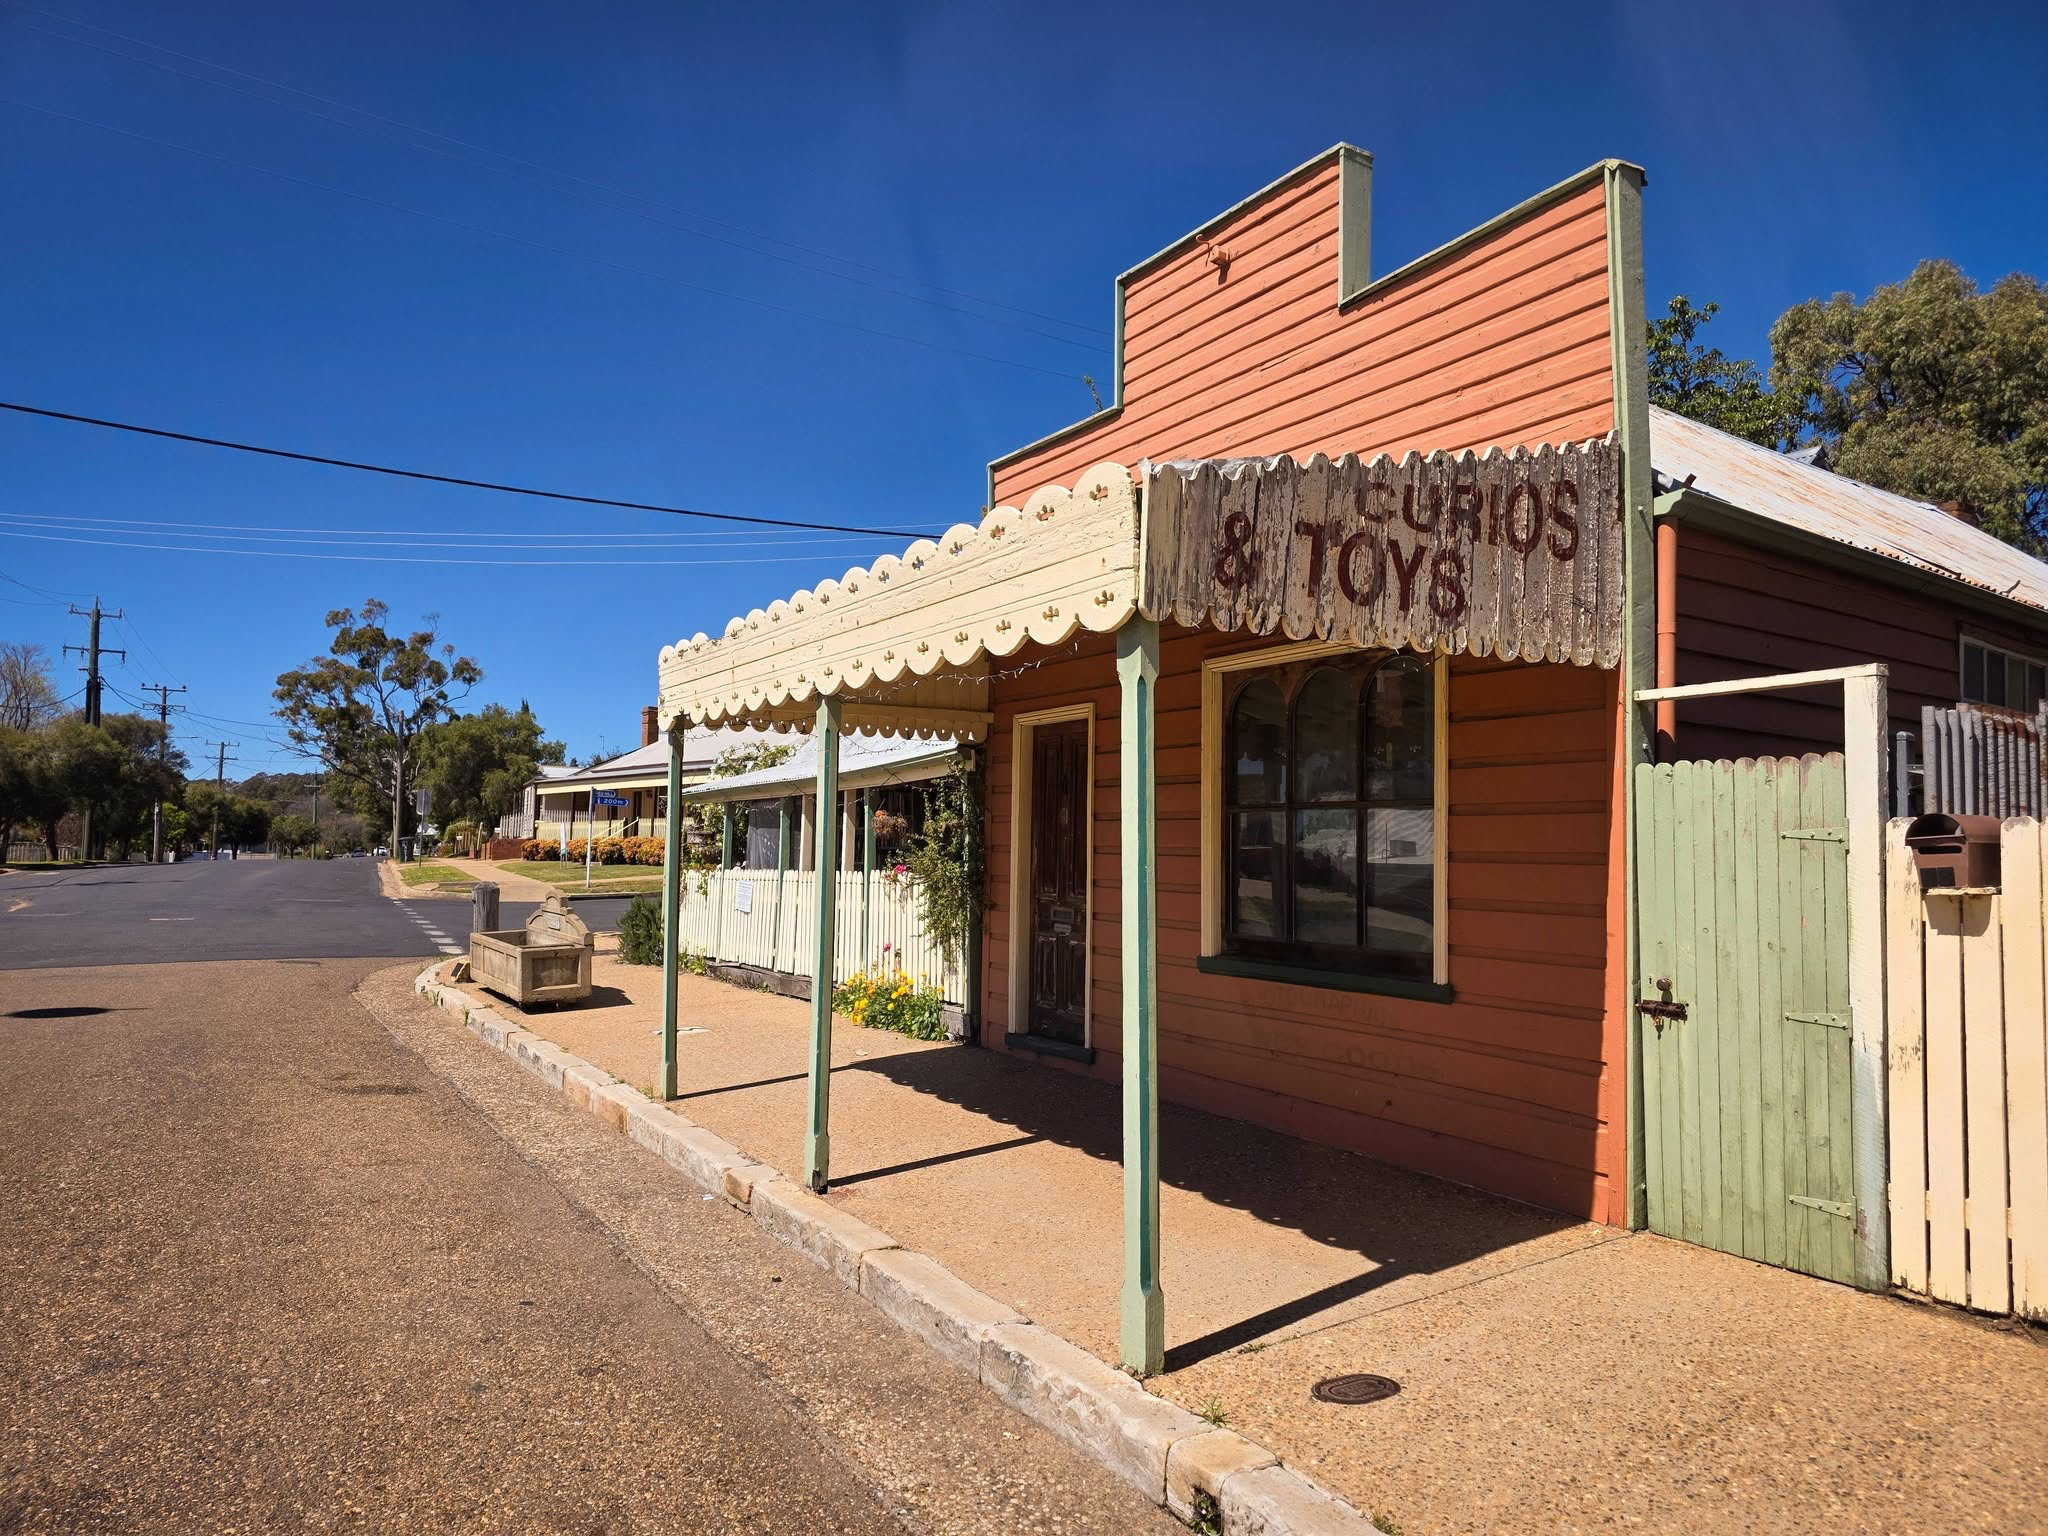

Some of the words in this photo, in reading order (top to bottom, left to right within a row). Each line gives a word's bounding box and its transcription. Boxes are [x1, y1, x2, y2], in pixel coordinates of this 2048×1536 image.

[1215, 511, 1263, 589] &
[1295, 521, 1465, 619] TOYS
[1355, 480, 1579, 561] CURIOS
